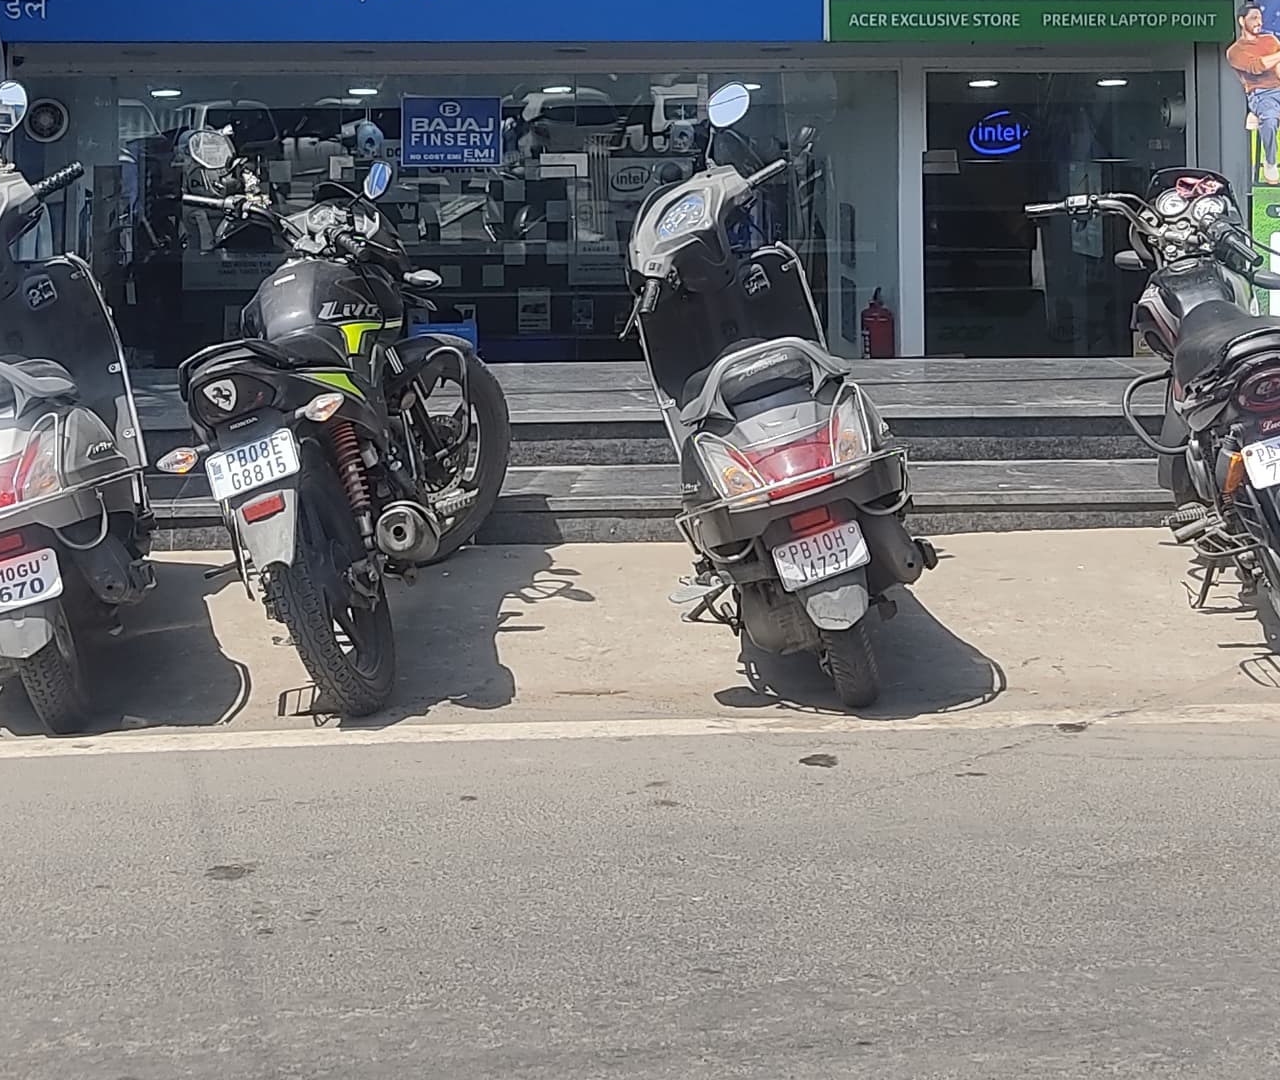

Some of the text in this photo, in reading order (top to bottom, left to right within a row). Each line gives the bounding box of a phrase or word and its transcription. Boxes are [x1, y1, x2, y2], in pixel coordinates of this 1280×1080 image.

[848, 13, 1021, 27] ACER EXCLUSIVE STORE
[1042, 13, 1217, 27] PREMIER LAPTOP POINT
[411, 117, 495, 132] BAJAJ
[977, 122, 1023, 142] intel
[411, 133, 494, 147] FINSERV
[463, 148, 495, 158] EMI
[229, 416, 260, 431] HONDA
[225, 436, 282, 473] PB08E
[230, 455, 288, 491] G8815
[788, 527, 847, 565] PB10H
